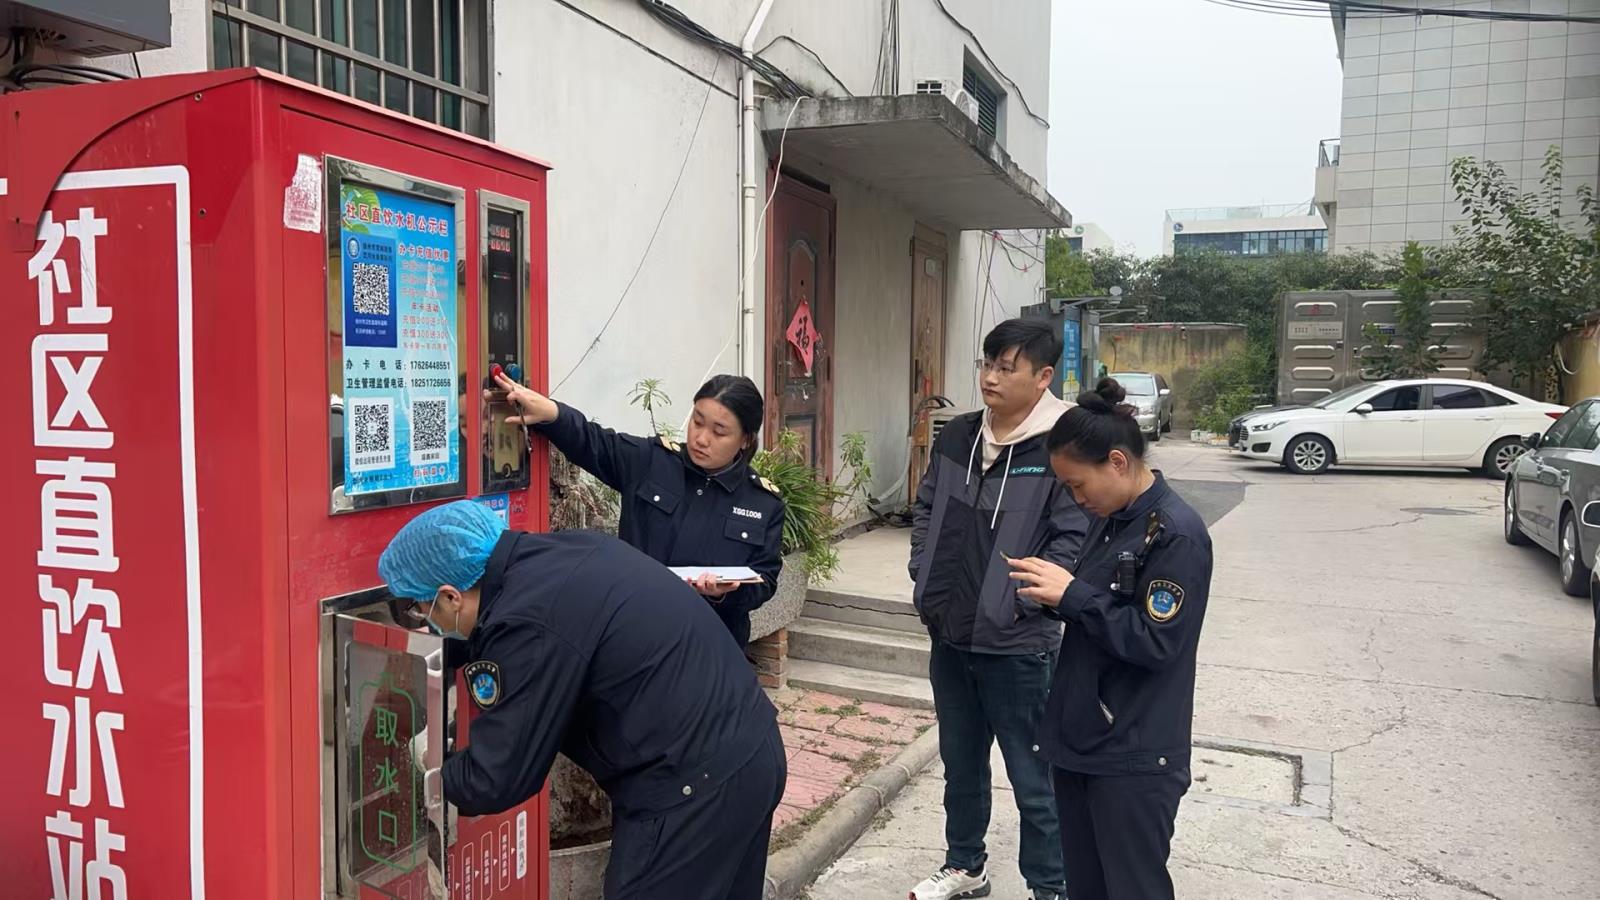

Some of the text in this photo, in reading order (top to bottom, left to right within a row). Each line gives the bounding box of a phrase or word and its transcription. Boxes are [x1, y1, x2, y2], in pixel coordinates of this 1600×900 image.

[345, 201, 449, 237] 社区直饮水机公示栏
[796, 315, 810, 355] 福
[28, 207, 128, 900] 社区直饮水站
[375, 706, 400, 847] 取水口
